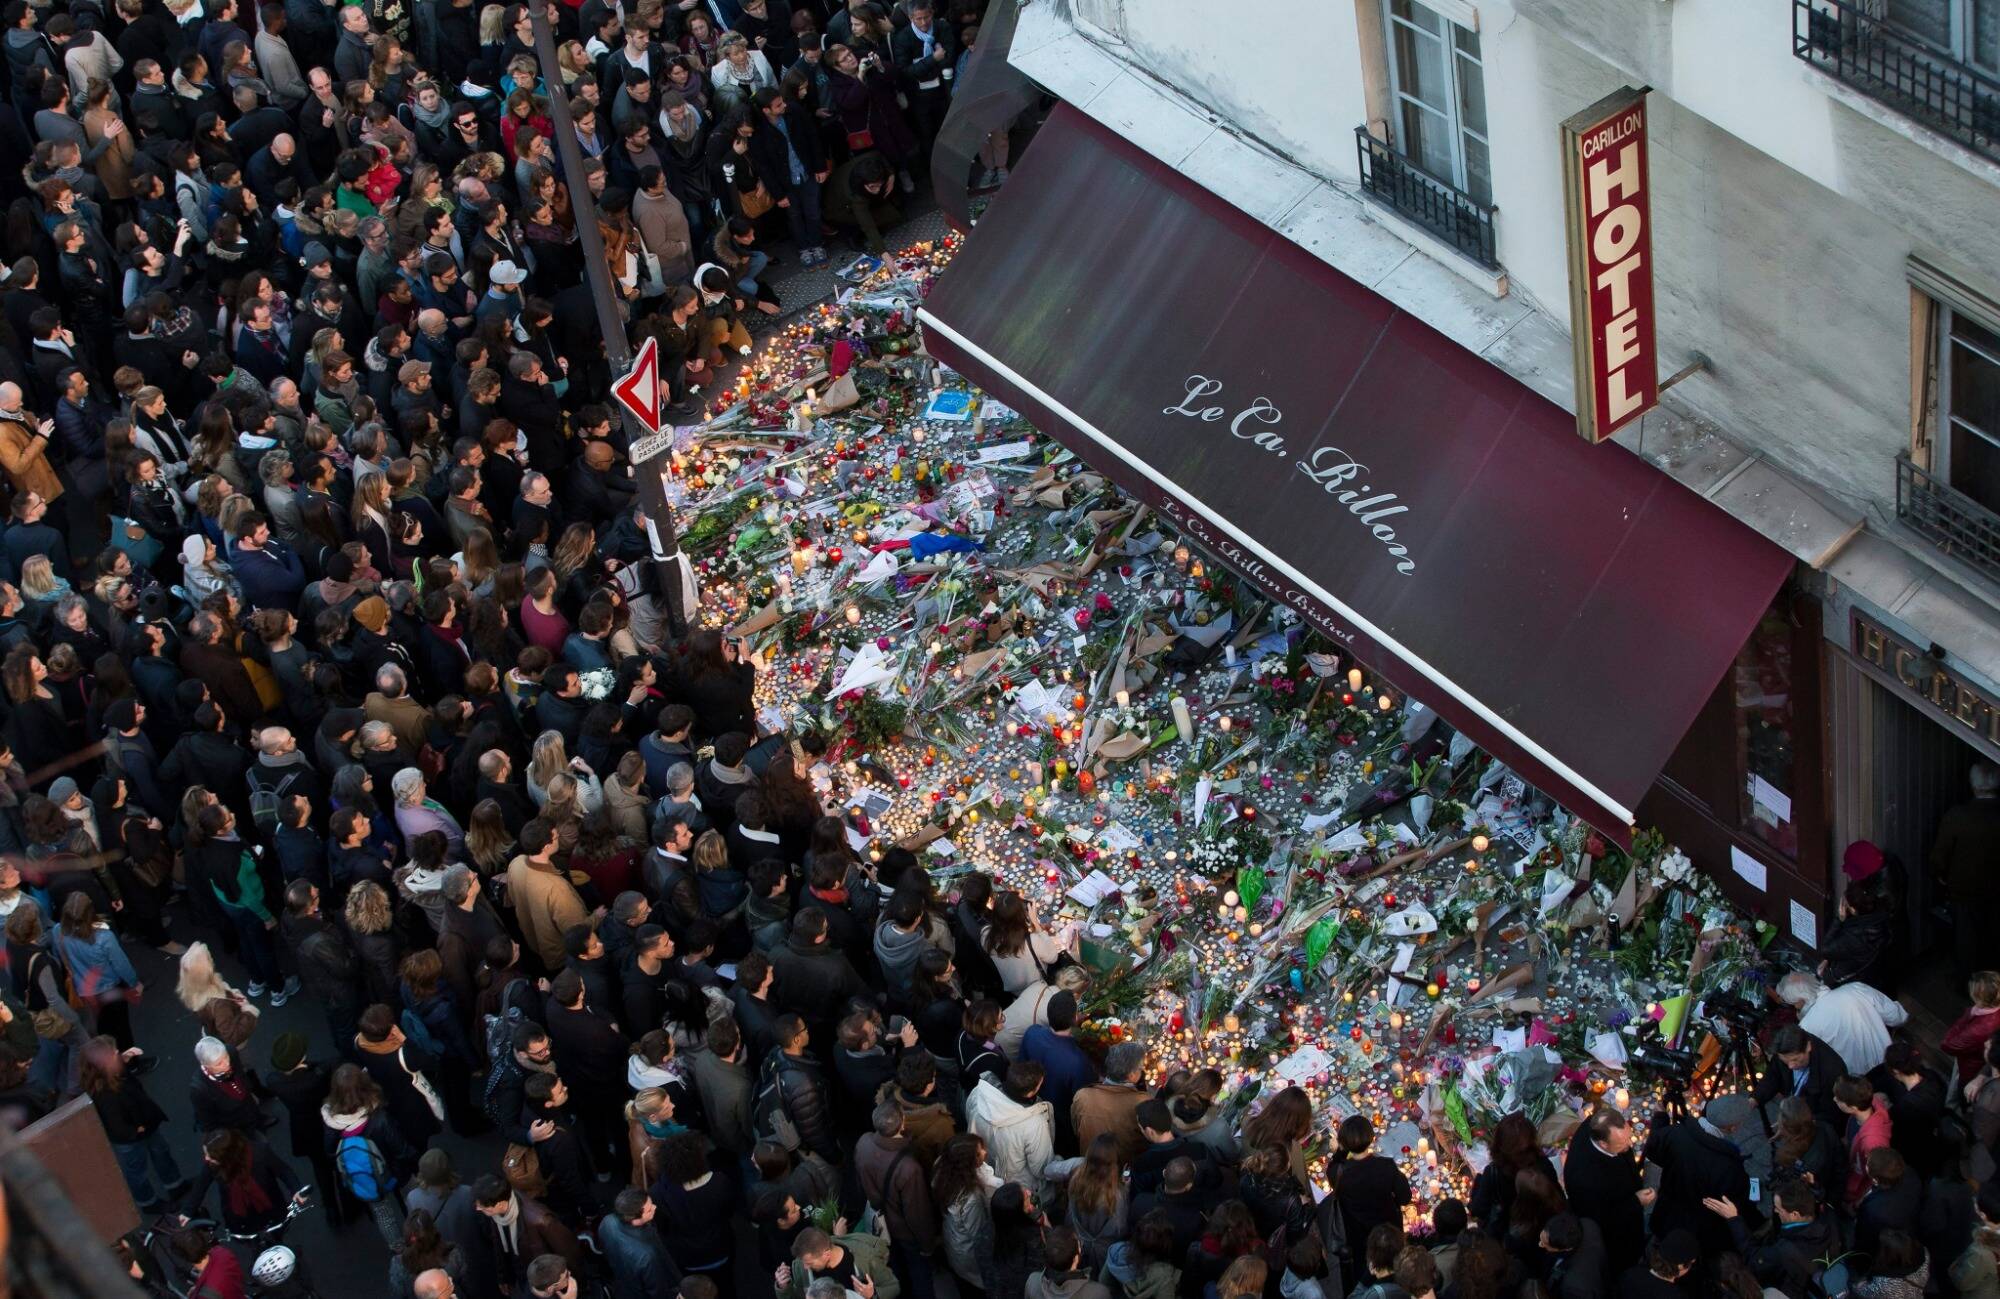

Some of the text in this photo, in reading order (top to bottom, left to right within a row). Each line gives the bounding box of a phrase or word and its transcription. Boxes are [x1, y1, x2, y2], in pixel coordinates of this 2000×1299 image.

[1583, 111, 1642, 159] CARILLON
[1589, 142, 1642, 424] HOTEL
[639, 439, 668, 458] PASSAGE
[661, 431, 668, 439] LE
[1163, 375, 1415, 576] Le Ca. Rillon
[1160, 497, 1183, 521] Le
[1218, 541, 1282, 593] Rillon
